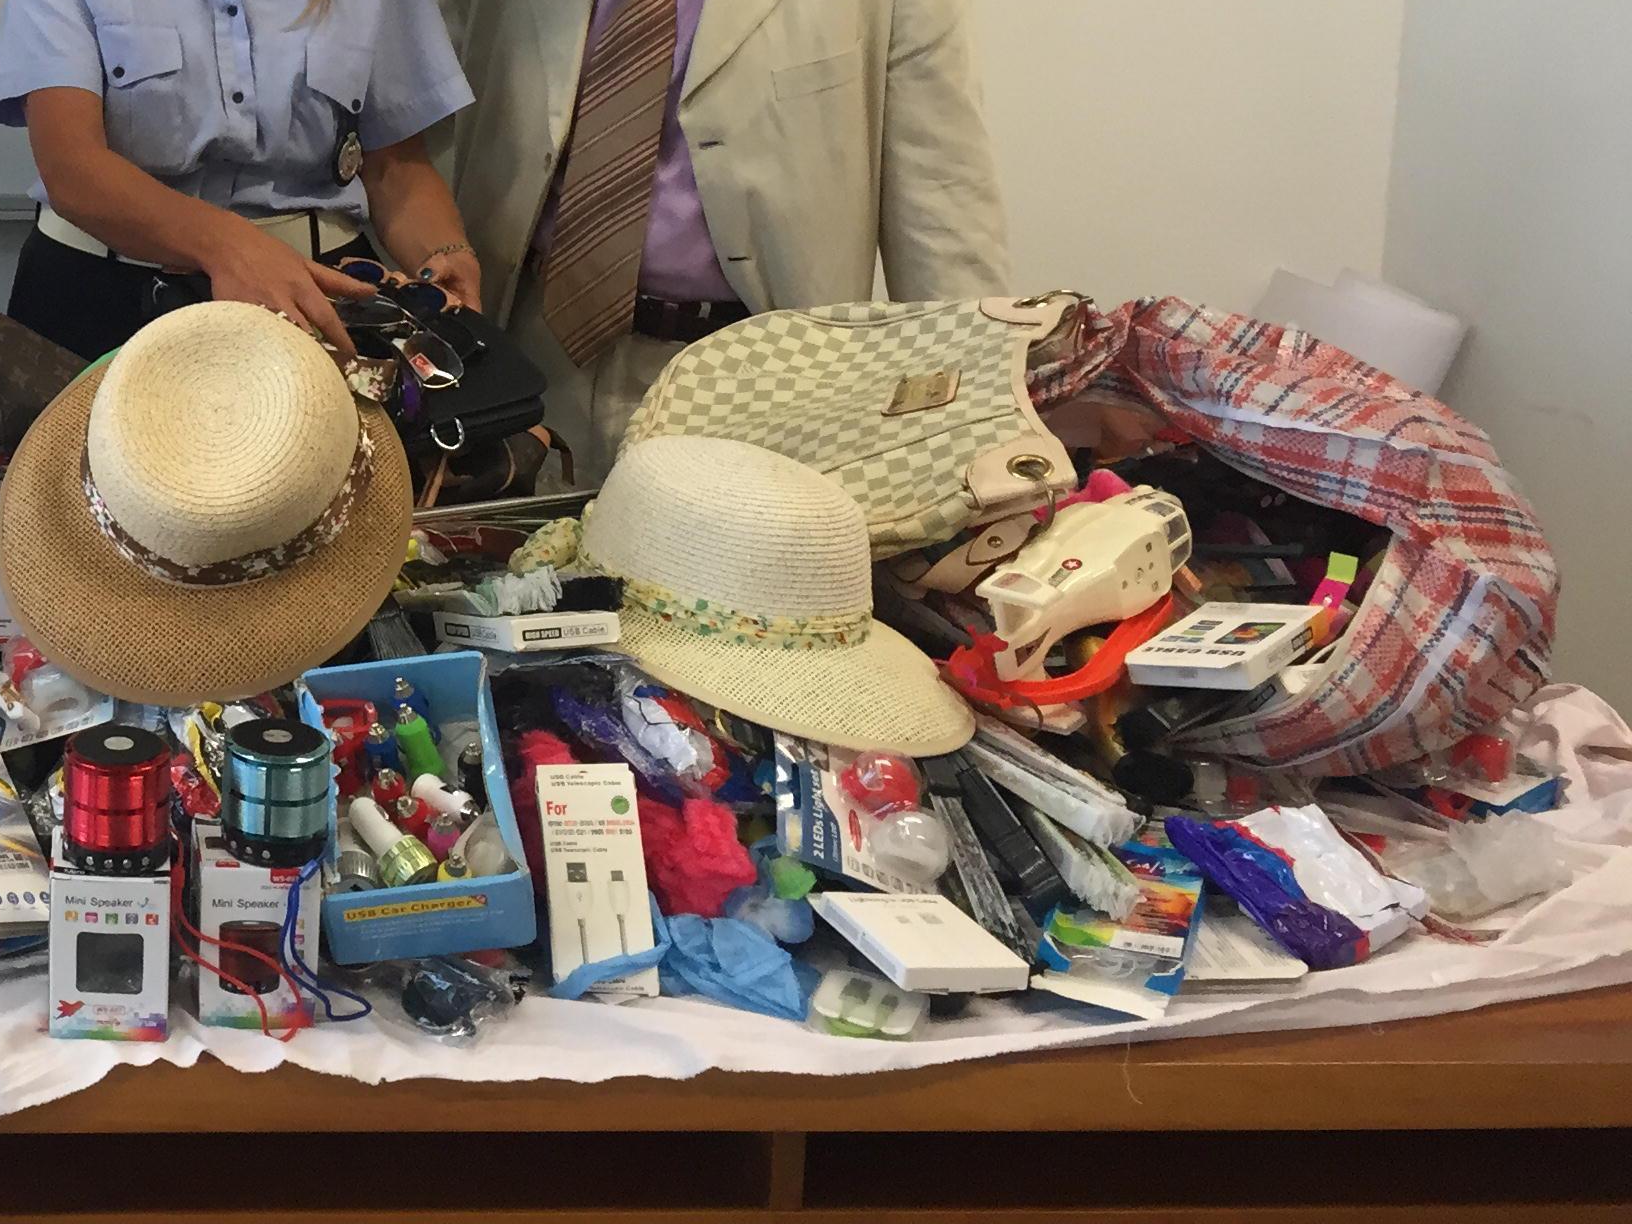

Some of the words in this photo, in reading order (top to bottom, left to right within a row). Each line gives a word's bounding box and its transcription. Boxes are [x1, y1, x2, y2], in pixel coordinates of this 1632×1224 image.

[562, 627, 580, 637] USB
[582, 625, 606, 635] Cable
[546, 801, 567, 816] For
[812, 821, 825, 849] LEDs
[813, 850, 825, 860] 2
[65, 895, 87, 906] Mini
[90, 896, 134, 908] Speaker
[212, 898, 233, 908] Mini
[236, 898, 280, 910] Speaker
[345, 909, 376, 921] USB
[381, 906, 405, 916] Car
[410, 897, 473, 912] Charger
